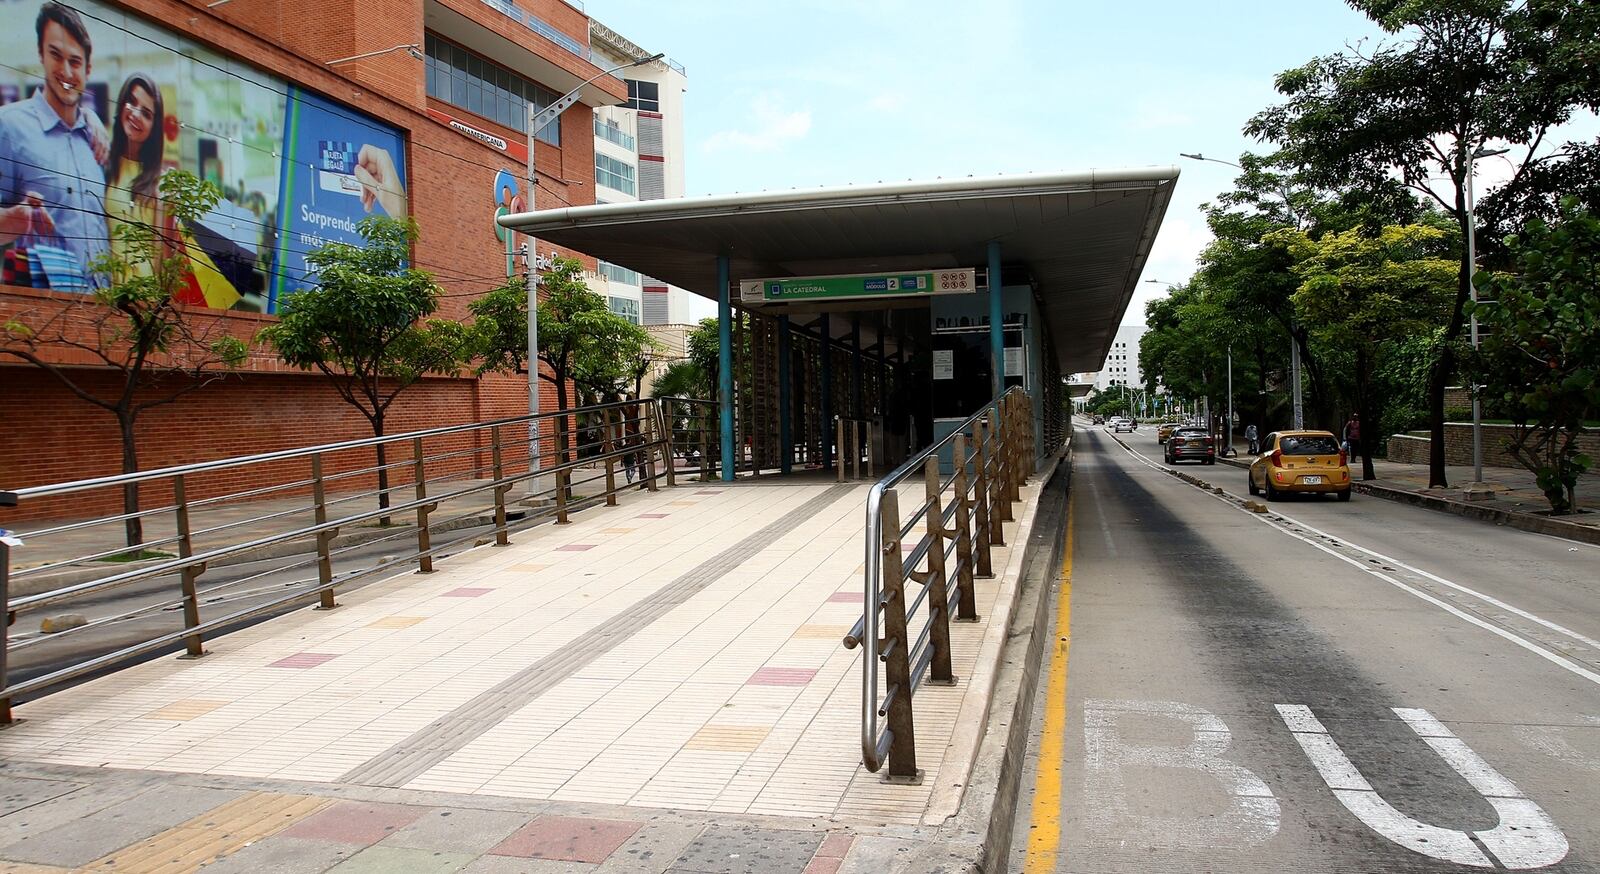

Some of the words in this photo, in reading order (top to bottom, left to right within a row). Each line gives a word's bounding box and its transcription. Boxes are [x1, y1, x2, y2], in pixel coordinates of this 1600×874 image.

[453, 123, 504, 149] PANAMERICANA
[301, 203, 357, 234] Sorprende
[793, 286, 827, 294] CATEDRAL
[889, 280, 896, 288] 2
[1083, 698, 1600, 870] BU
